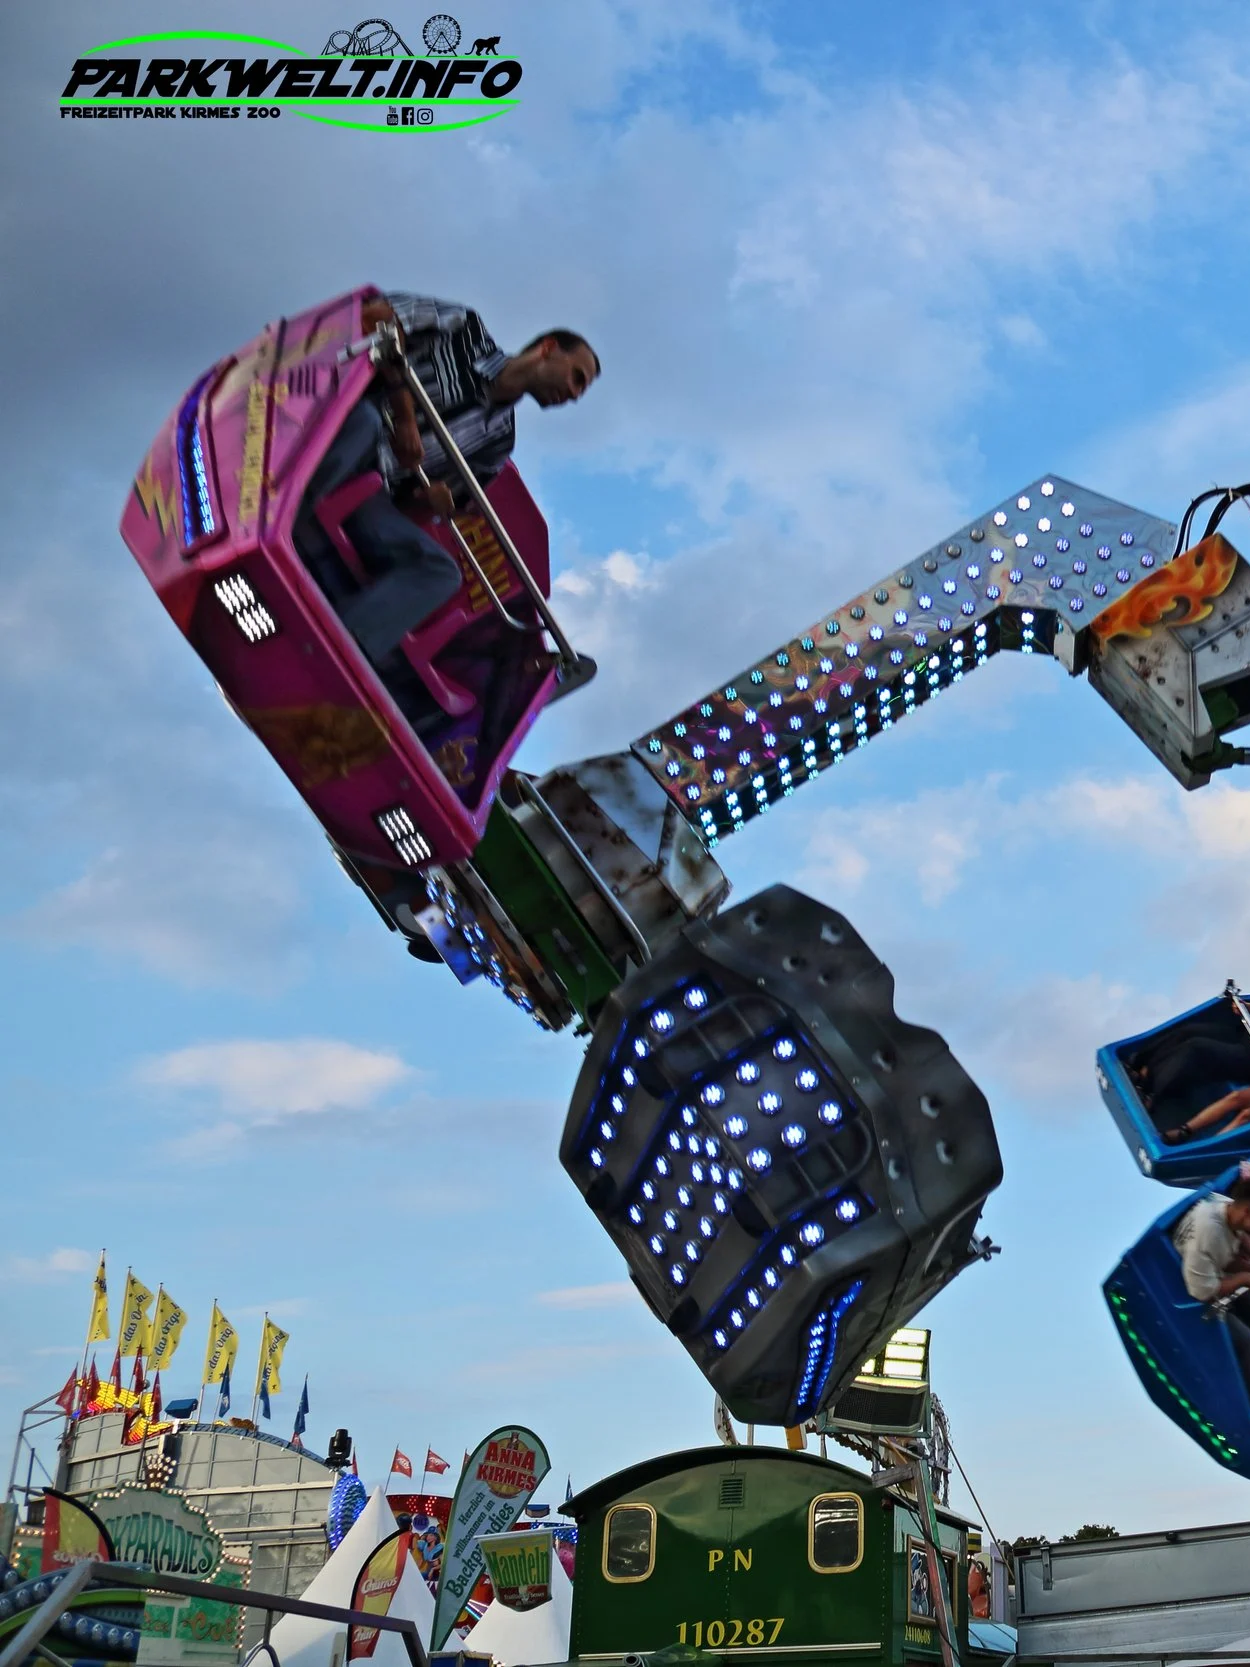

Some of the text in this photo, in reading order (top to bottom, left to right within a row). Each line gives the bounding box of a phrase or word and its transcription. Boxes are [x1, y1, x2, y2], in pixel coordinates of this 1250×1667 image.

[484, 1441, 536, 1471] ANNA
[476, 1463, 538, 1492] KIRMES
[457, 1491, 486, 1527] Herzlich
[452, 1499, 496, 1559] willkommen im
[485, 1546, 550, 1588] Mandeln
[361, 1577, 398, 1594] Churros
[675, 1618, 785, 1648] 110287
